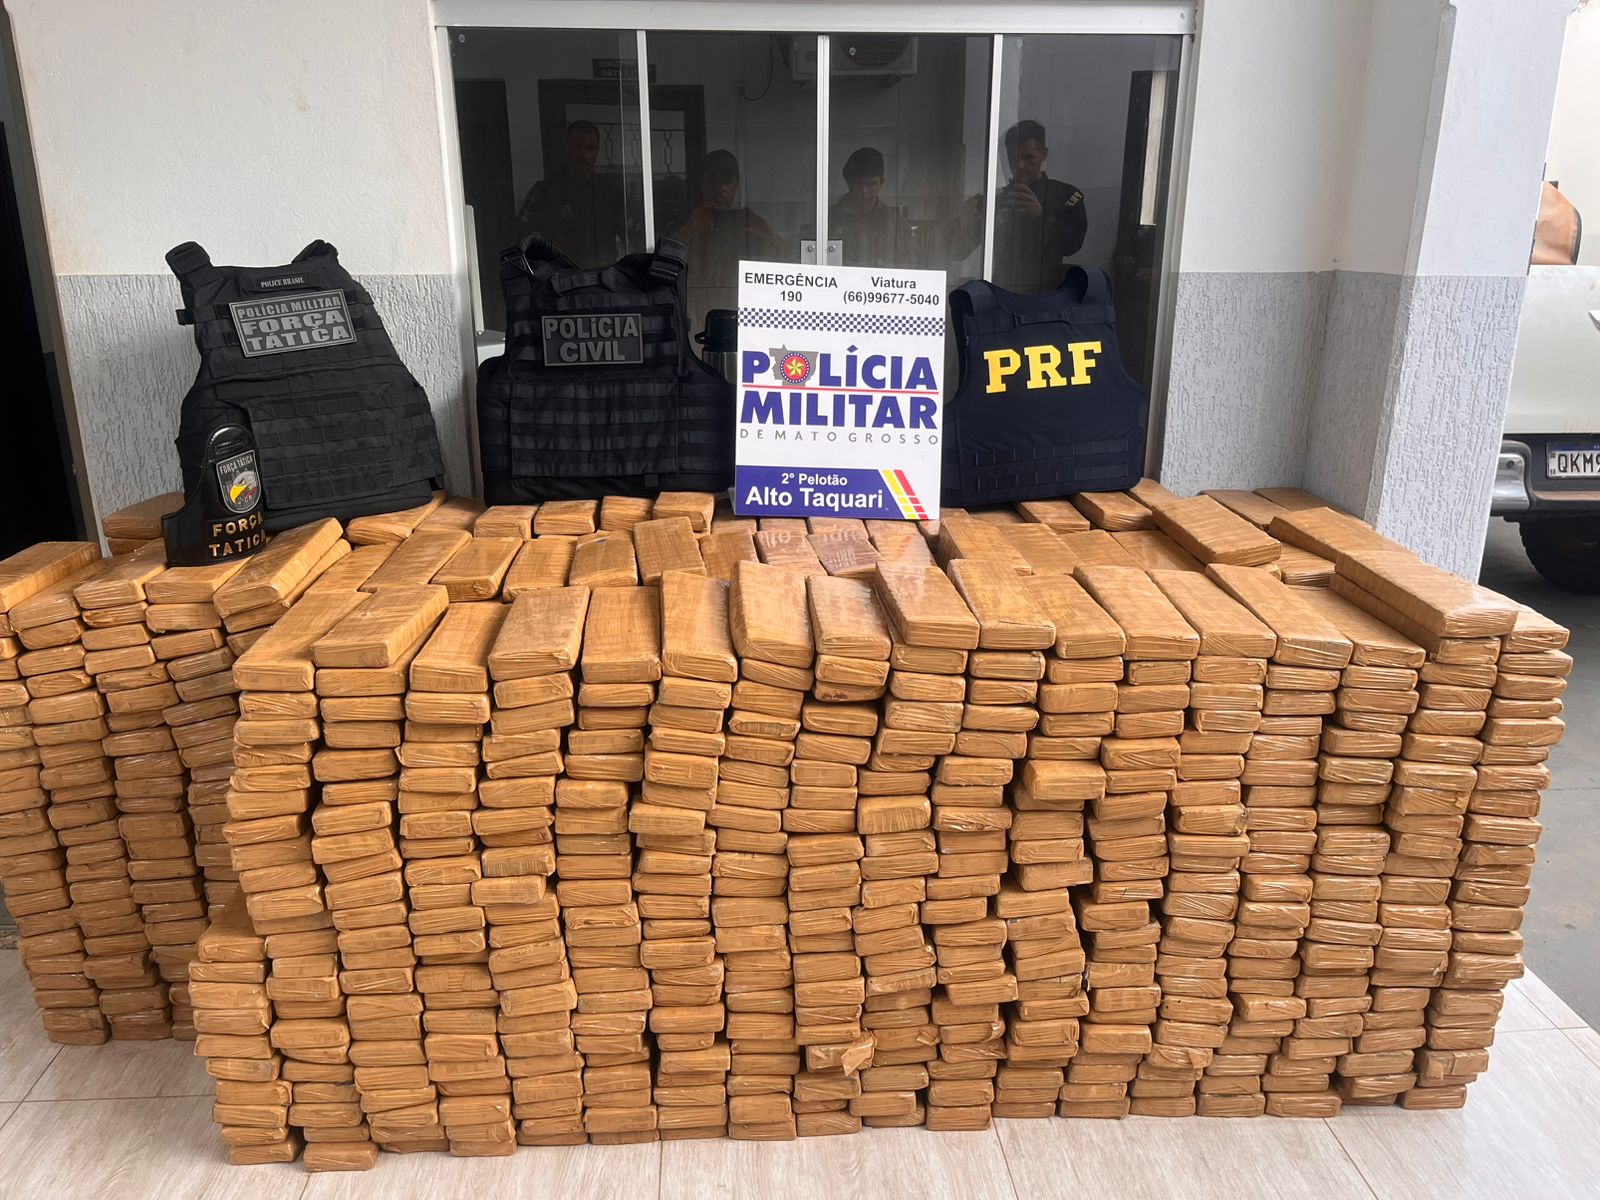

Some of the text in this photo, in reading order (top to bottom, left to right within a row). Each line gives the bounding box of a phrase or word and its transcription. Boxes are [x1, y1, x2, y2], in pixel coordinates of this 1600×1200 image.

[282, 276, 304, 285] BRASIL
[745, 272, 838, 288] EMERGÊNCIA
[871, 276, 916, 289] Viatura
[780, 290, 802, 302] 190
[843, 291, 940, 305] (66)99677-5040
[237, 296, 341, 319] POLÍCIA MILITAR
[241, 310, 345, 336] FORÇA
[246, 325, 350, 351] TÁTICA
[560, 340, 626, 362] CIVIL
[742, 344, 938, 391] POLÍCIA
[983, 341, 1102, 394] PRF
[740, 390, 938, 430] MILITAR
[848, 432, 938, 445] GROSSO
[220, 461, 238, 475] FORÇA
[799, 473, 848, 486] Pelotão
[745, 486, 883, 512] Alto Taquari
